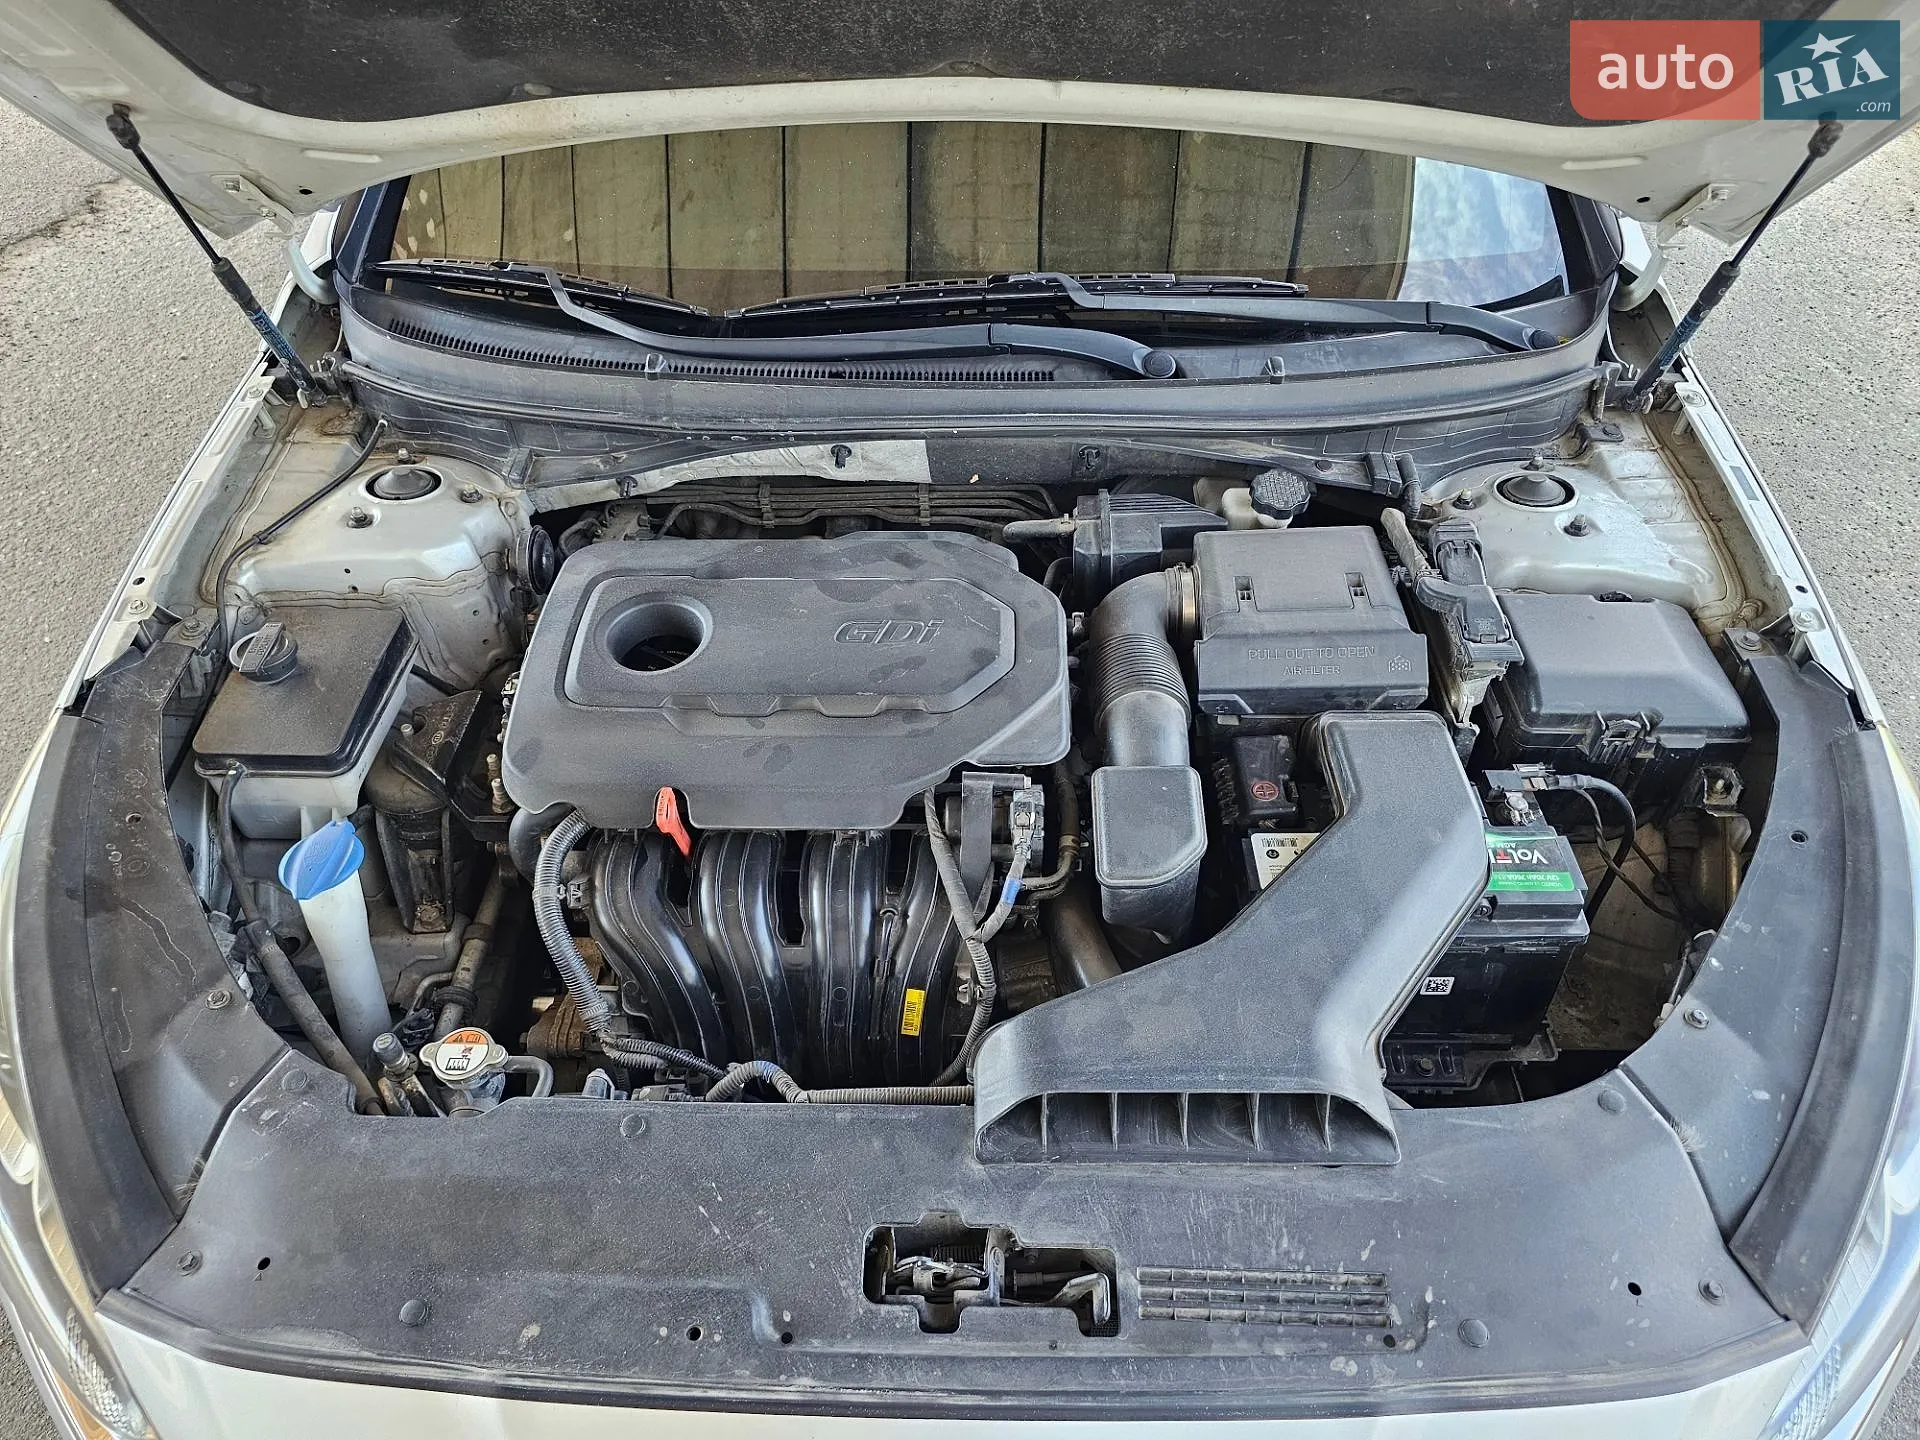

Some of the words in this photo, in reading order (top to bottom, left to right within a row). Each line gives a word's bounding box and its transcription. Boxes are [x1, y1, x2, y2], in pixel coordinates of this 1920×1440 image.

[833, 619, 945, 644] GDi
[1248, 649, 1280, 661] PULL
[1285, 648, 1314, 660] OUT
[1316, 647, 1334, 659] TO
[1337, 646, 1375, 658] OPEN
[1283, 665, 1302, 676] AIR
[1305, 665, 1341, 676] FILTER
